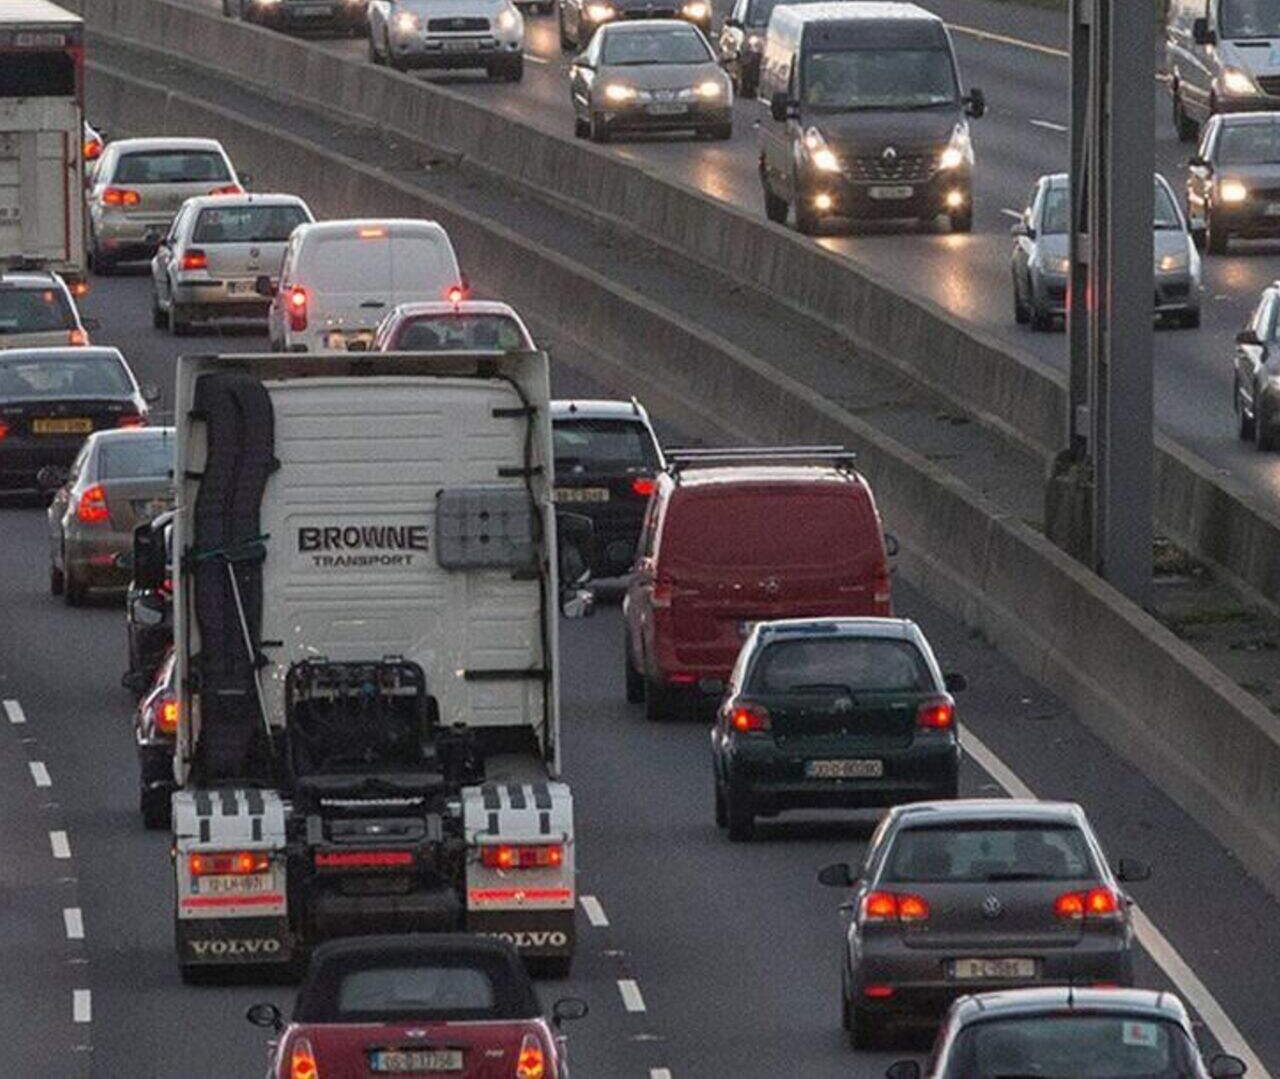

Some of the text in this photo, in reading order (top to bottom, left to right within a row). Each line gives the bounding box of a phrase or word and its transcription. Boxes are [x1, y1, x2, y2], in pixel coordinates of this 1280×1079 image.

[298, 525, 429, 553] BROWNE
[312, 554, 414, 568] TRANSPORT
[191, 938, 280, 954] VOLVO
[476, 931, 568, 947] OLVO
